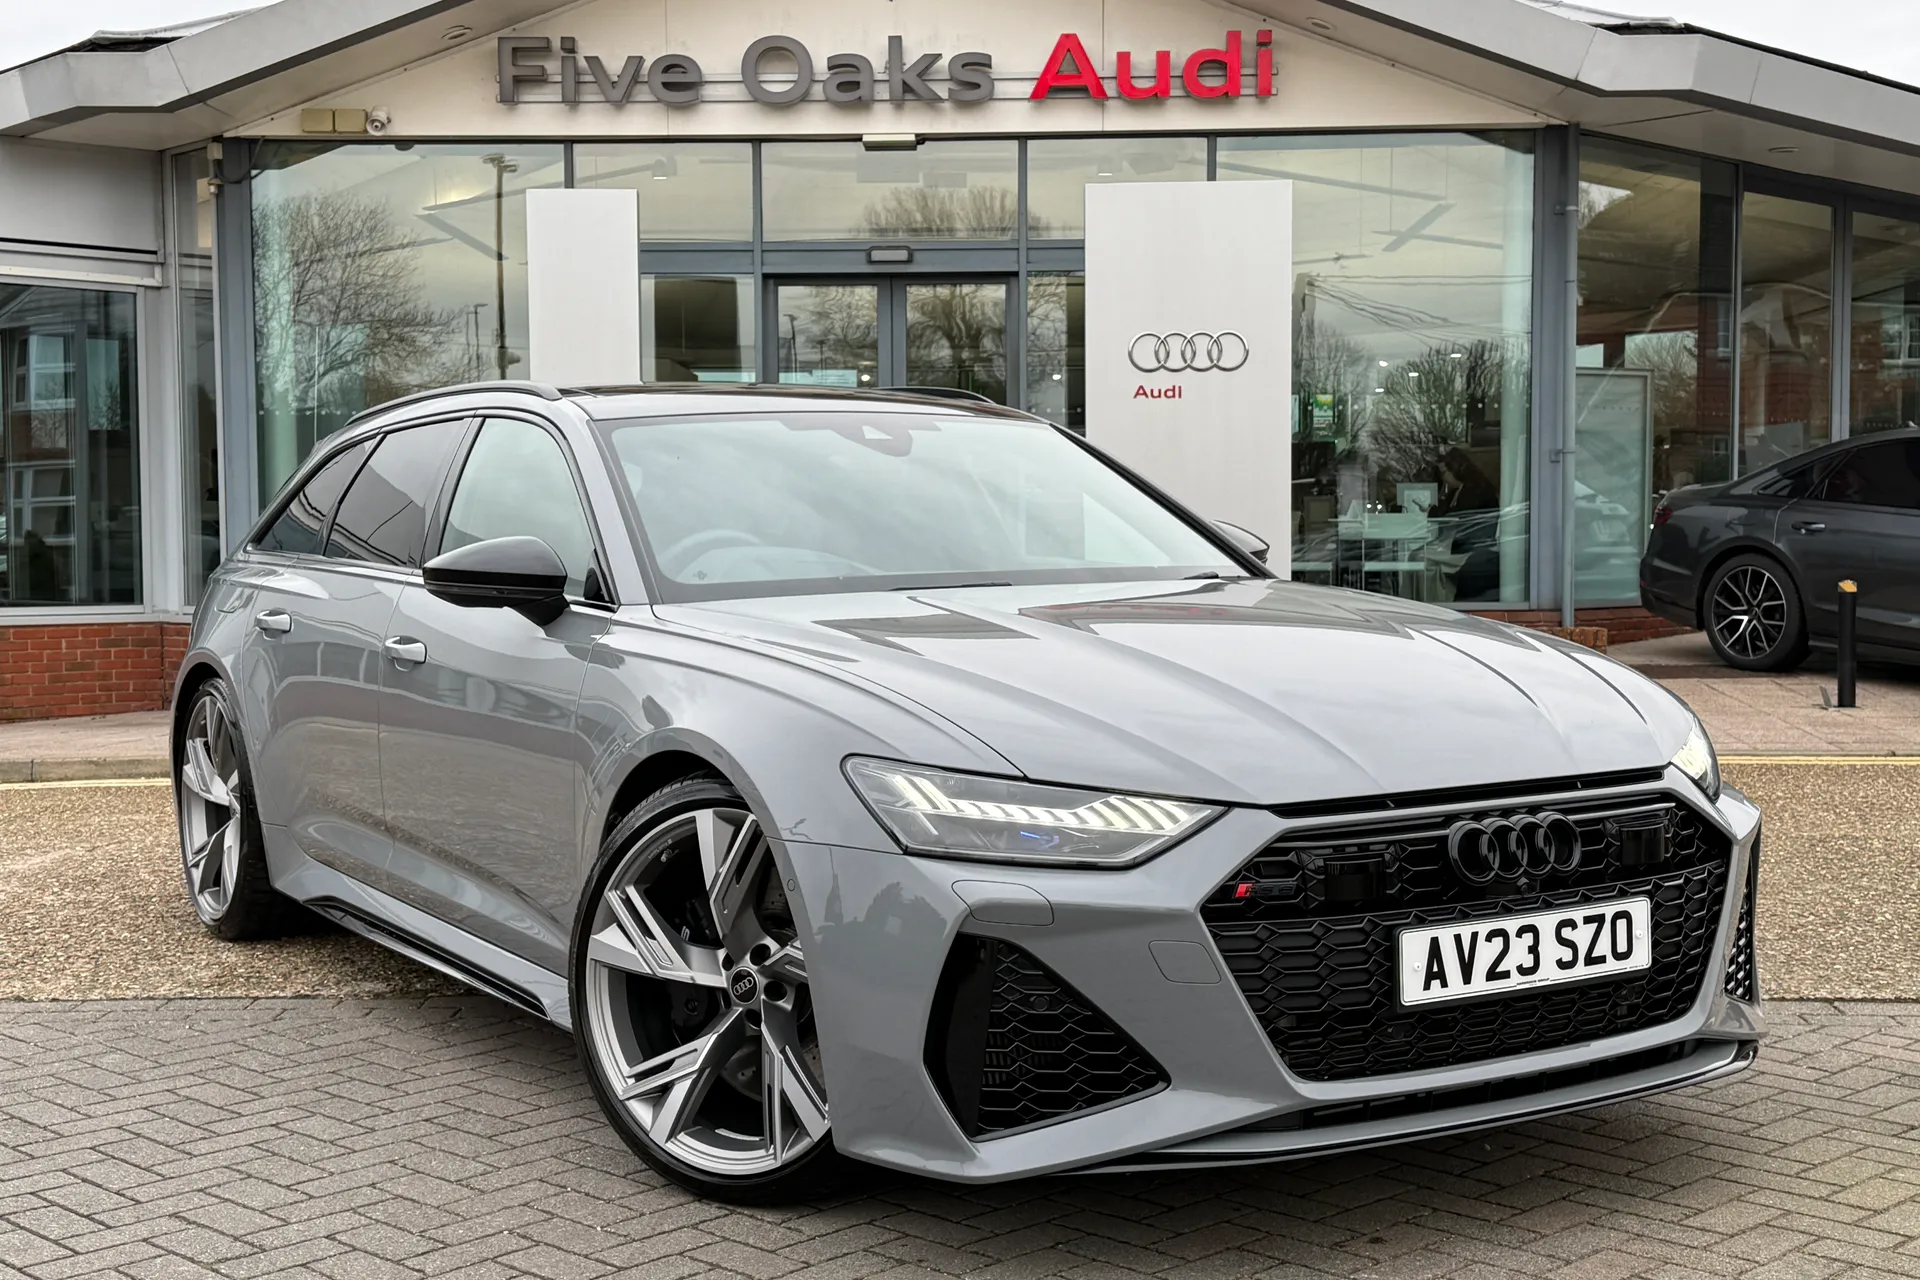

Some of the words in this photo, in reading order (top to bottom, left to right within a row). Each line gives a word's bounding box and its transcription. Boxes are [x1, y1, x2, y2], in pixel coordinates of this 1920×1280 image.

[497, 36, 702, 105] Five
[741, 34, 995, 105] Oaks
[1030, 29, 1274, 100] Audi
[1133, 384, 1183, 399] Audi
[1422, 924, 1541, 991] AV23
[1554, 909, 1634, 971] SZO
